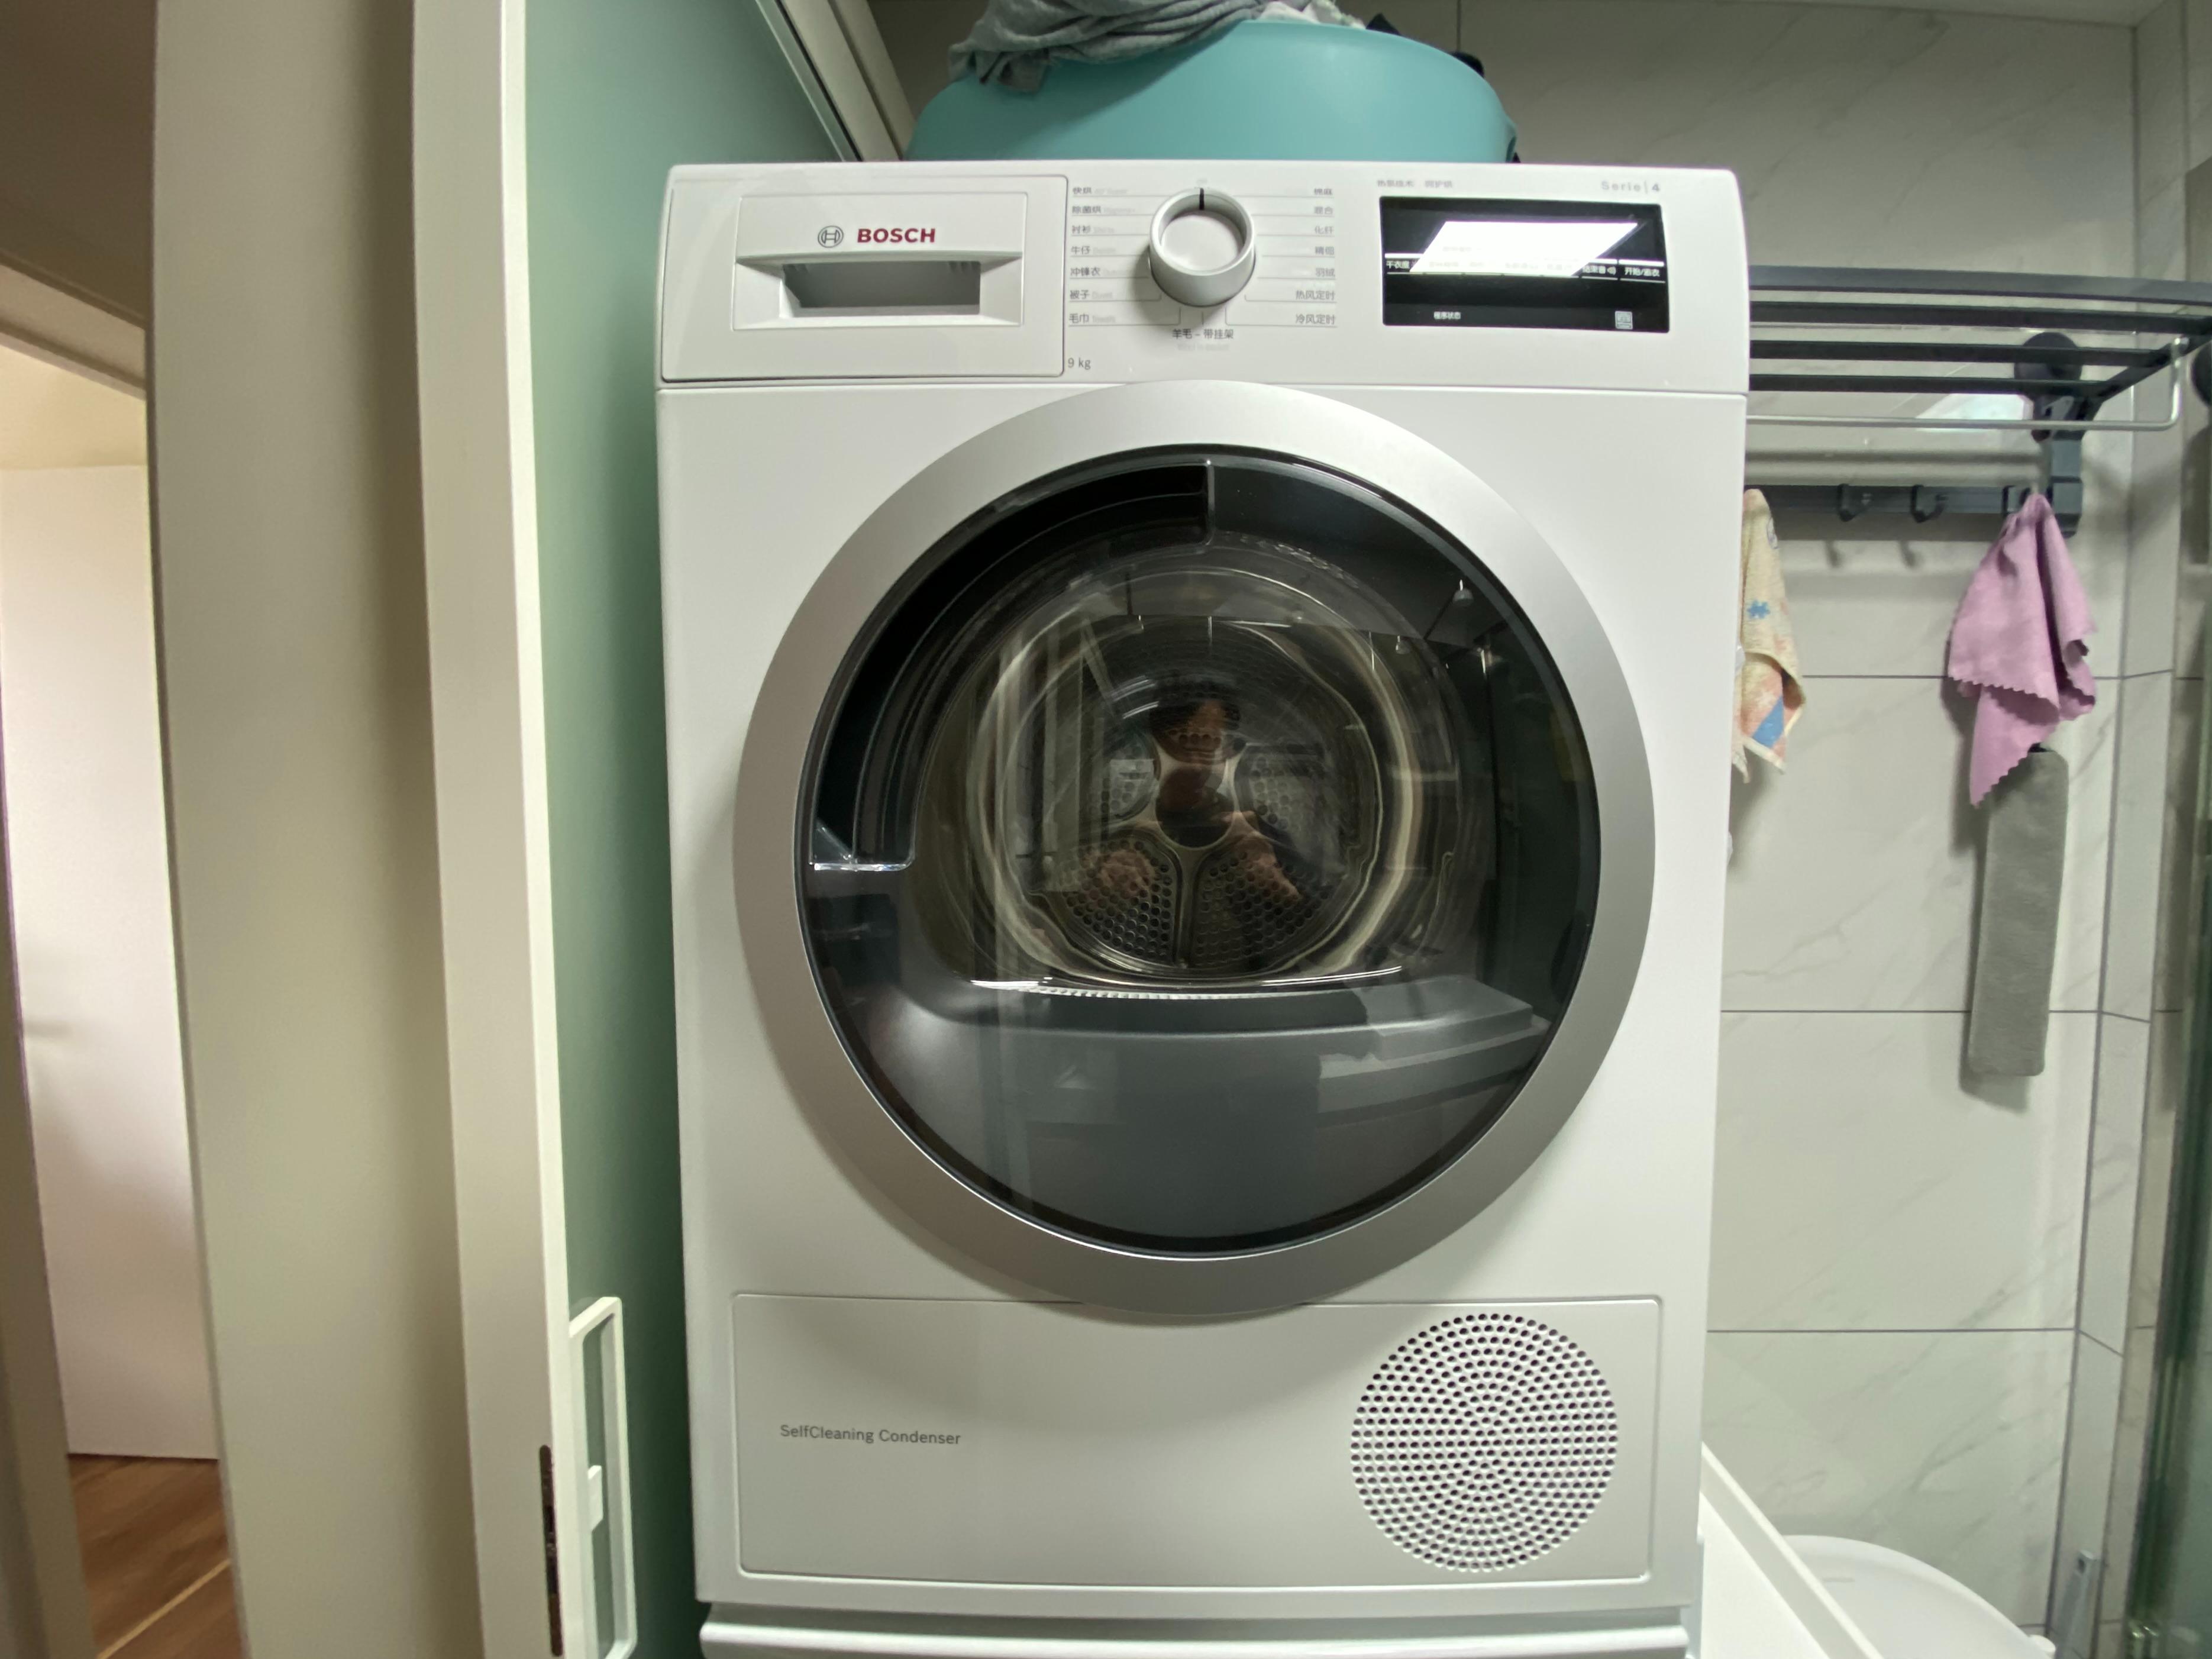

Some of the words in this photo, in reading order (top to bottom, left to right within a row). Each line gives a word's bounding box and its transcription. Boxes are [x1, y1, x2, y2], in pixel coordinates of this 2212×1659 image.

[1601, 180, 1641, 192] Serie
[1651, 183, 1661, 192] 4
[857, 228, 937, 243] BOSCH
[1071, 246, 1090, 254] 牛仔
[1070, 267, 1101, 276] 冲锋衣
[1070, 290, 1090, 299] 被子
[1295, 290, 1335, 301] 热风定时
[1069, 313, 1090, 324] 毛巾
[1295, 314, 1336, 325] 冷风定时
[1172, 329, 1193, 340] 羊毛
[1203, 329, 1234, 340] 带挂架
[1067, 358, 1075, 368] 9
[1078, 357, 1091, 370] kg
[780, 1424, 874, 1444] SelfCleaning
[879, 1429, 961, 1444] Condenser
